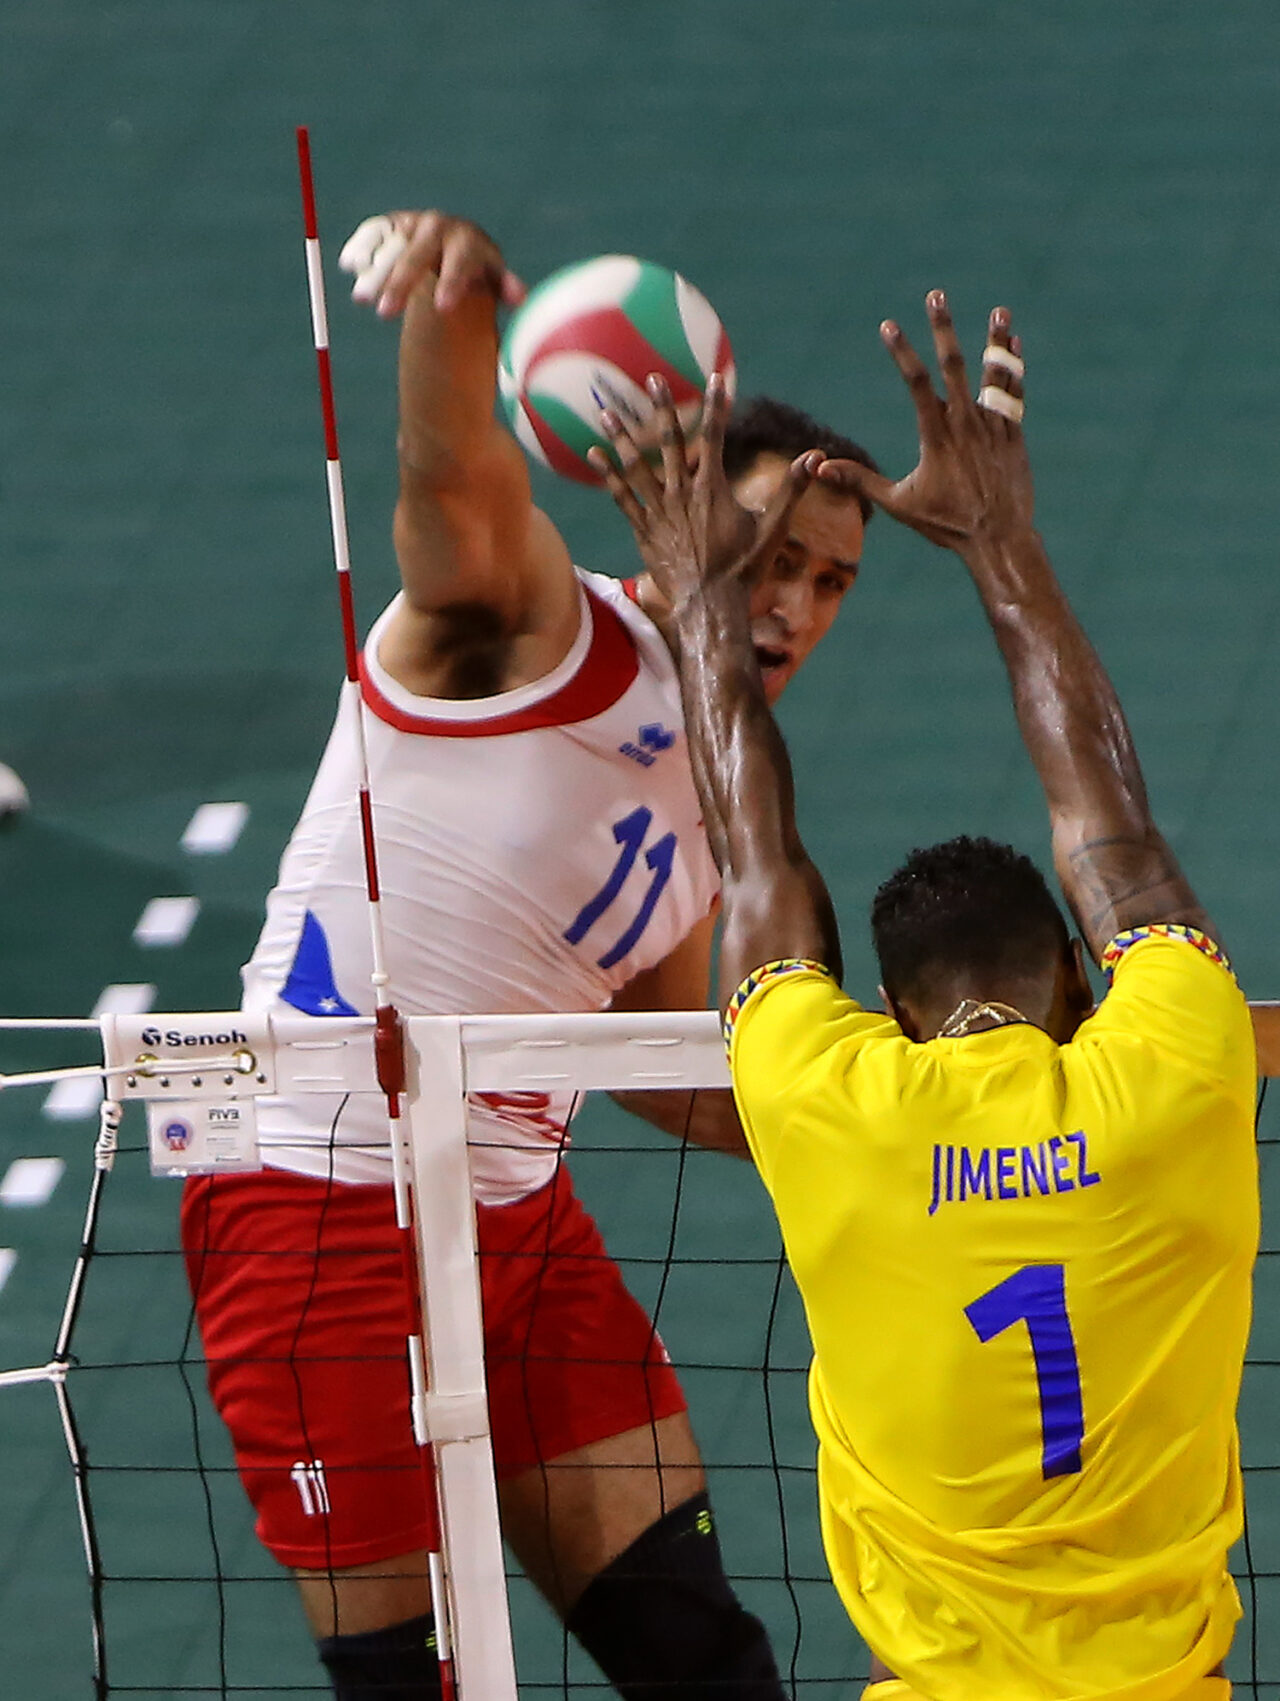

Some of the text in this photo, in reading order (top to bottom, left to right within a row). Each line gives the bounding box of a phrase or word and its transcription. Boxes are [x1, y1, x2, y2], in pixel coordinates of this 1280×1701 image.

[563, 805, 677, 969] 11
[165, 1030, 247, 1047] Senoh
[928, 1130, 1101, 1216] JIMENEZ
[963, 1263, 1084, 1481] 1
[290, 1459, 331, 1515] 11
